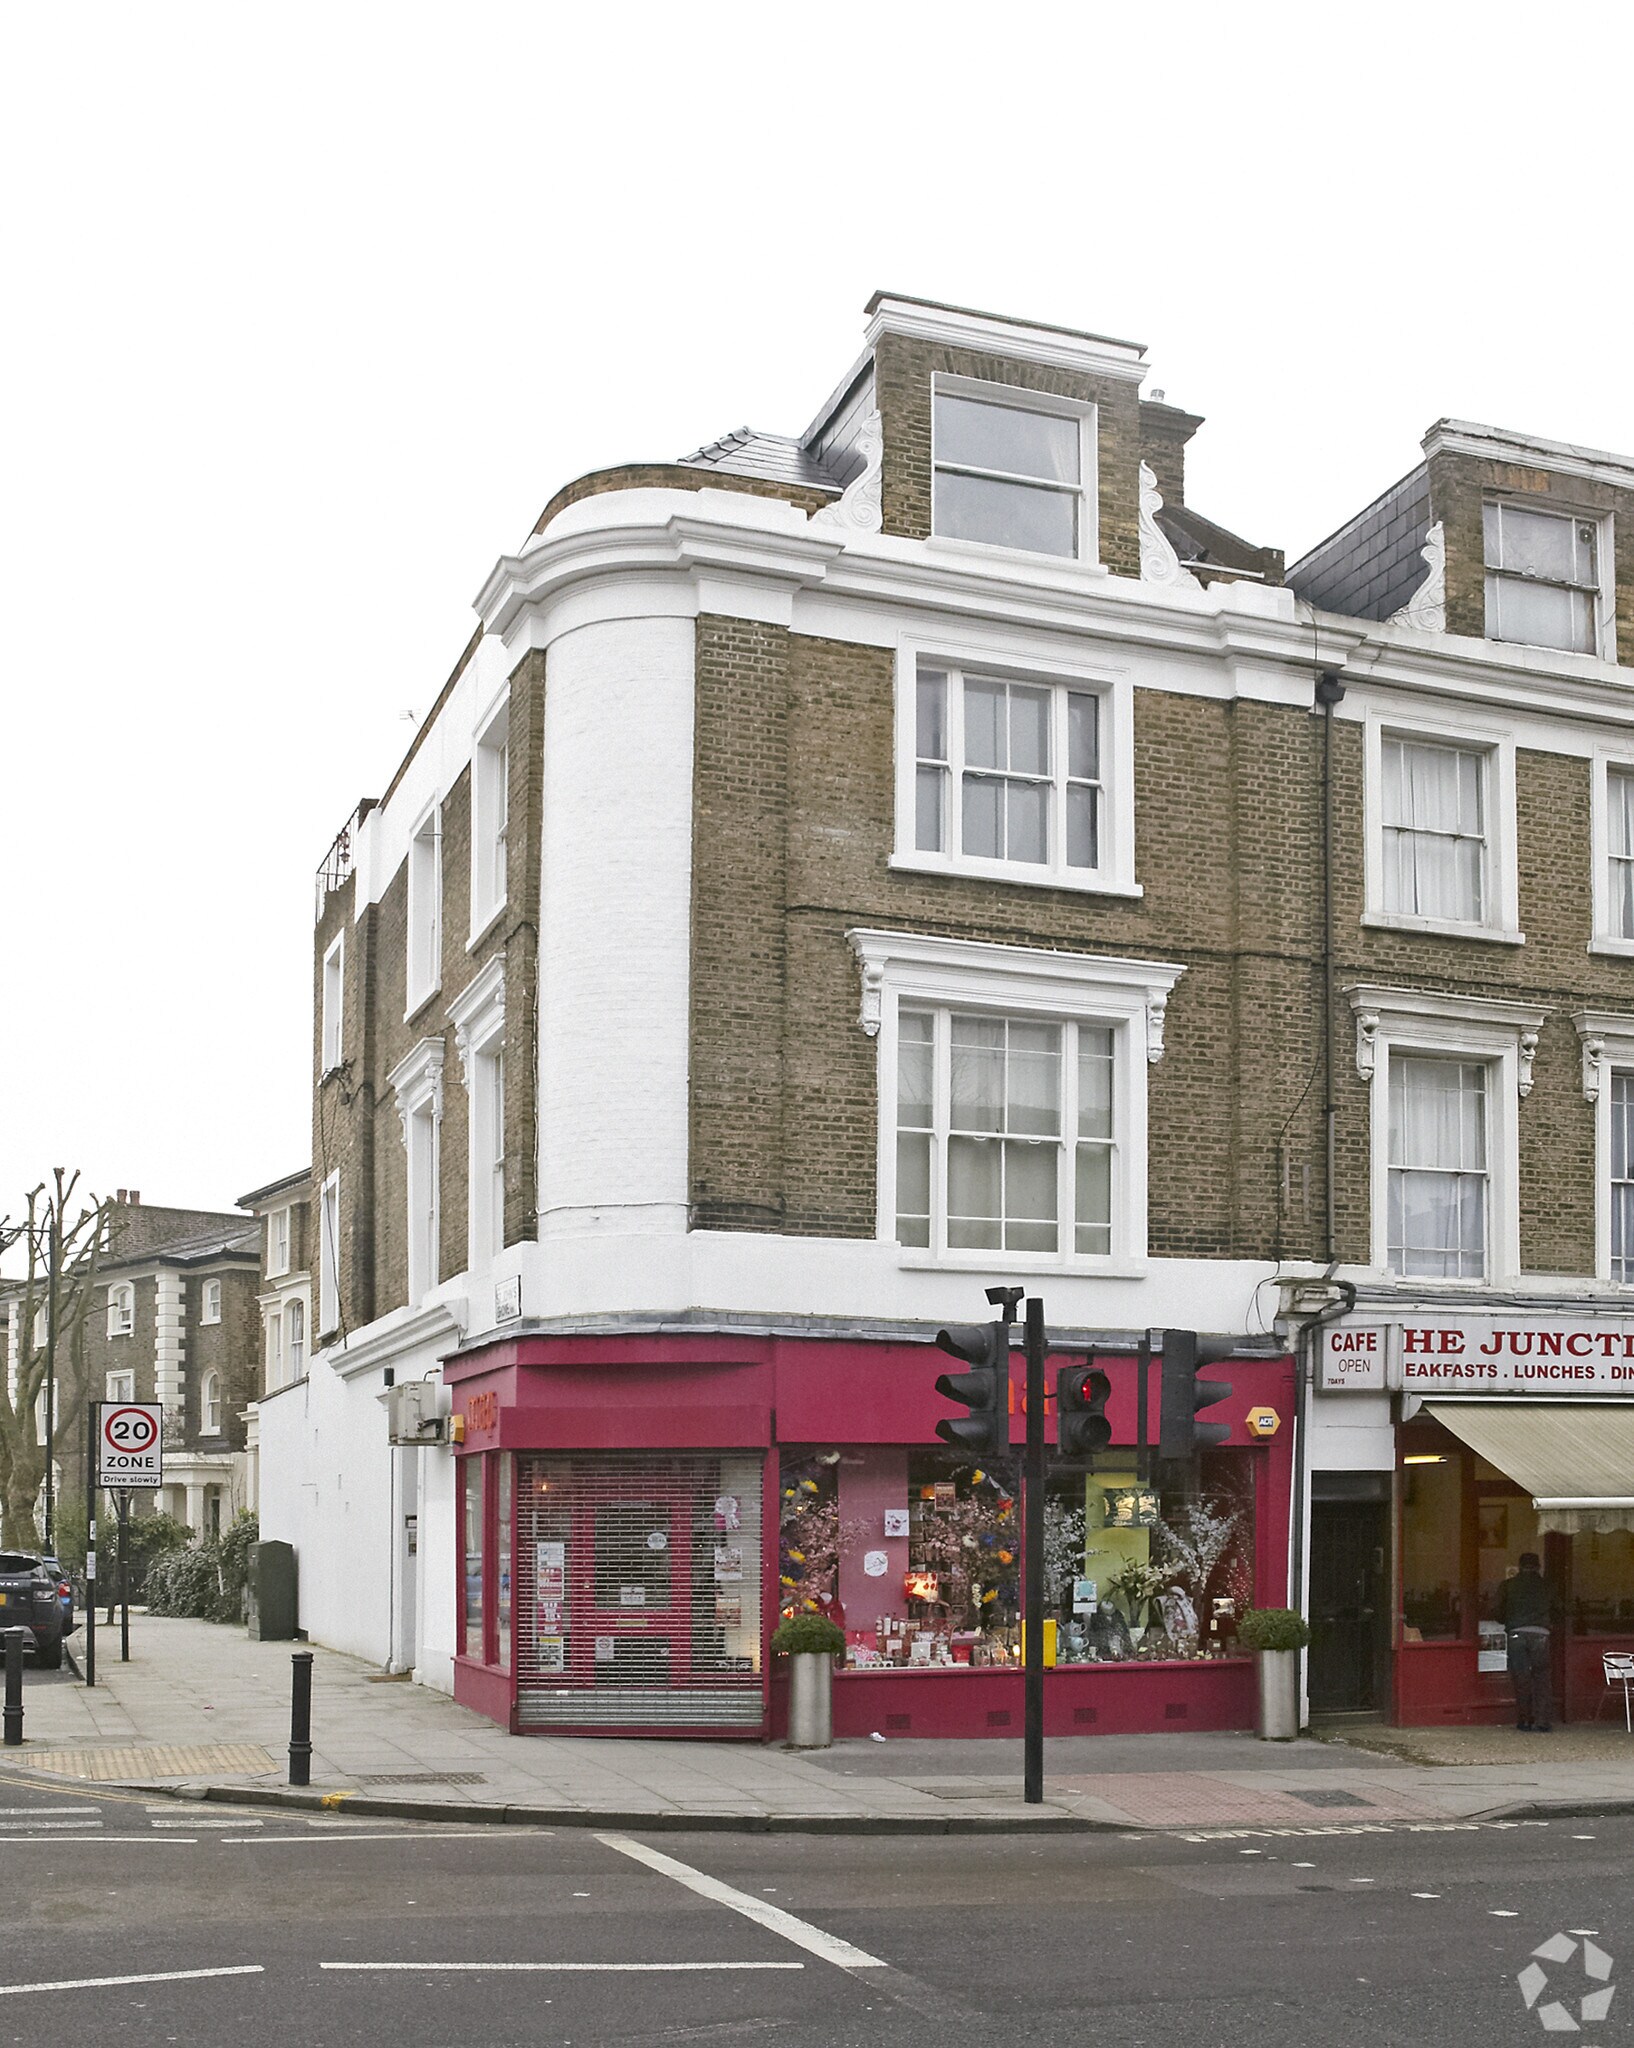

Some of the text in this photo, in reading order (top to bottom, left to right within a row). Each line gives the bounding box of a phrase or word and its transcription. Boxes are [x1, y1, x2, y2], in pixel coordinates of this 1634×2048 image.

[1331, 1333, 1377, 1352] CAFE
[1403, 1329, 1465, 1354] HE
[1338, 1359, 1371, 1372] OPEN
[1405, 1363, 1498, 1378] EAKFASTS
[1514, 1365, 1596, 1379] LUNCHES
[114, 1421, 150, 1440] 20
[106, 1456, 154, 1468] ZONE
[129, 1475, 158, 1484] slowly
